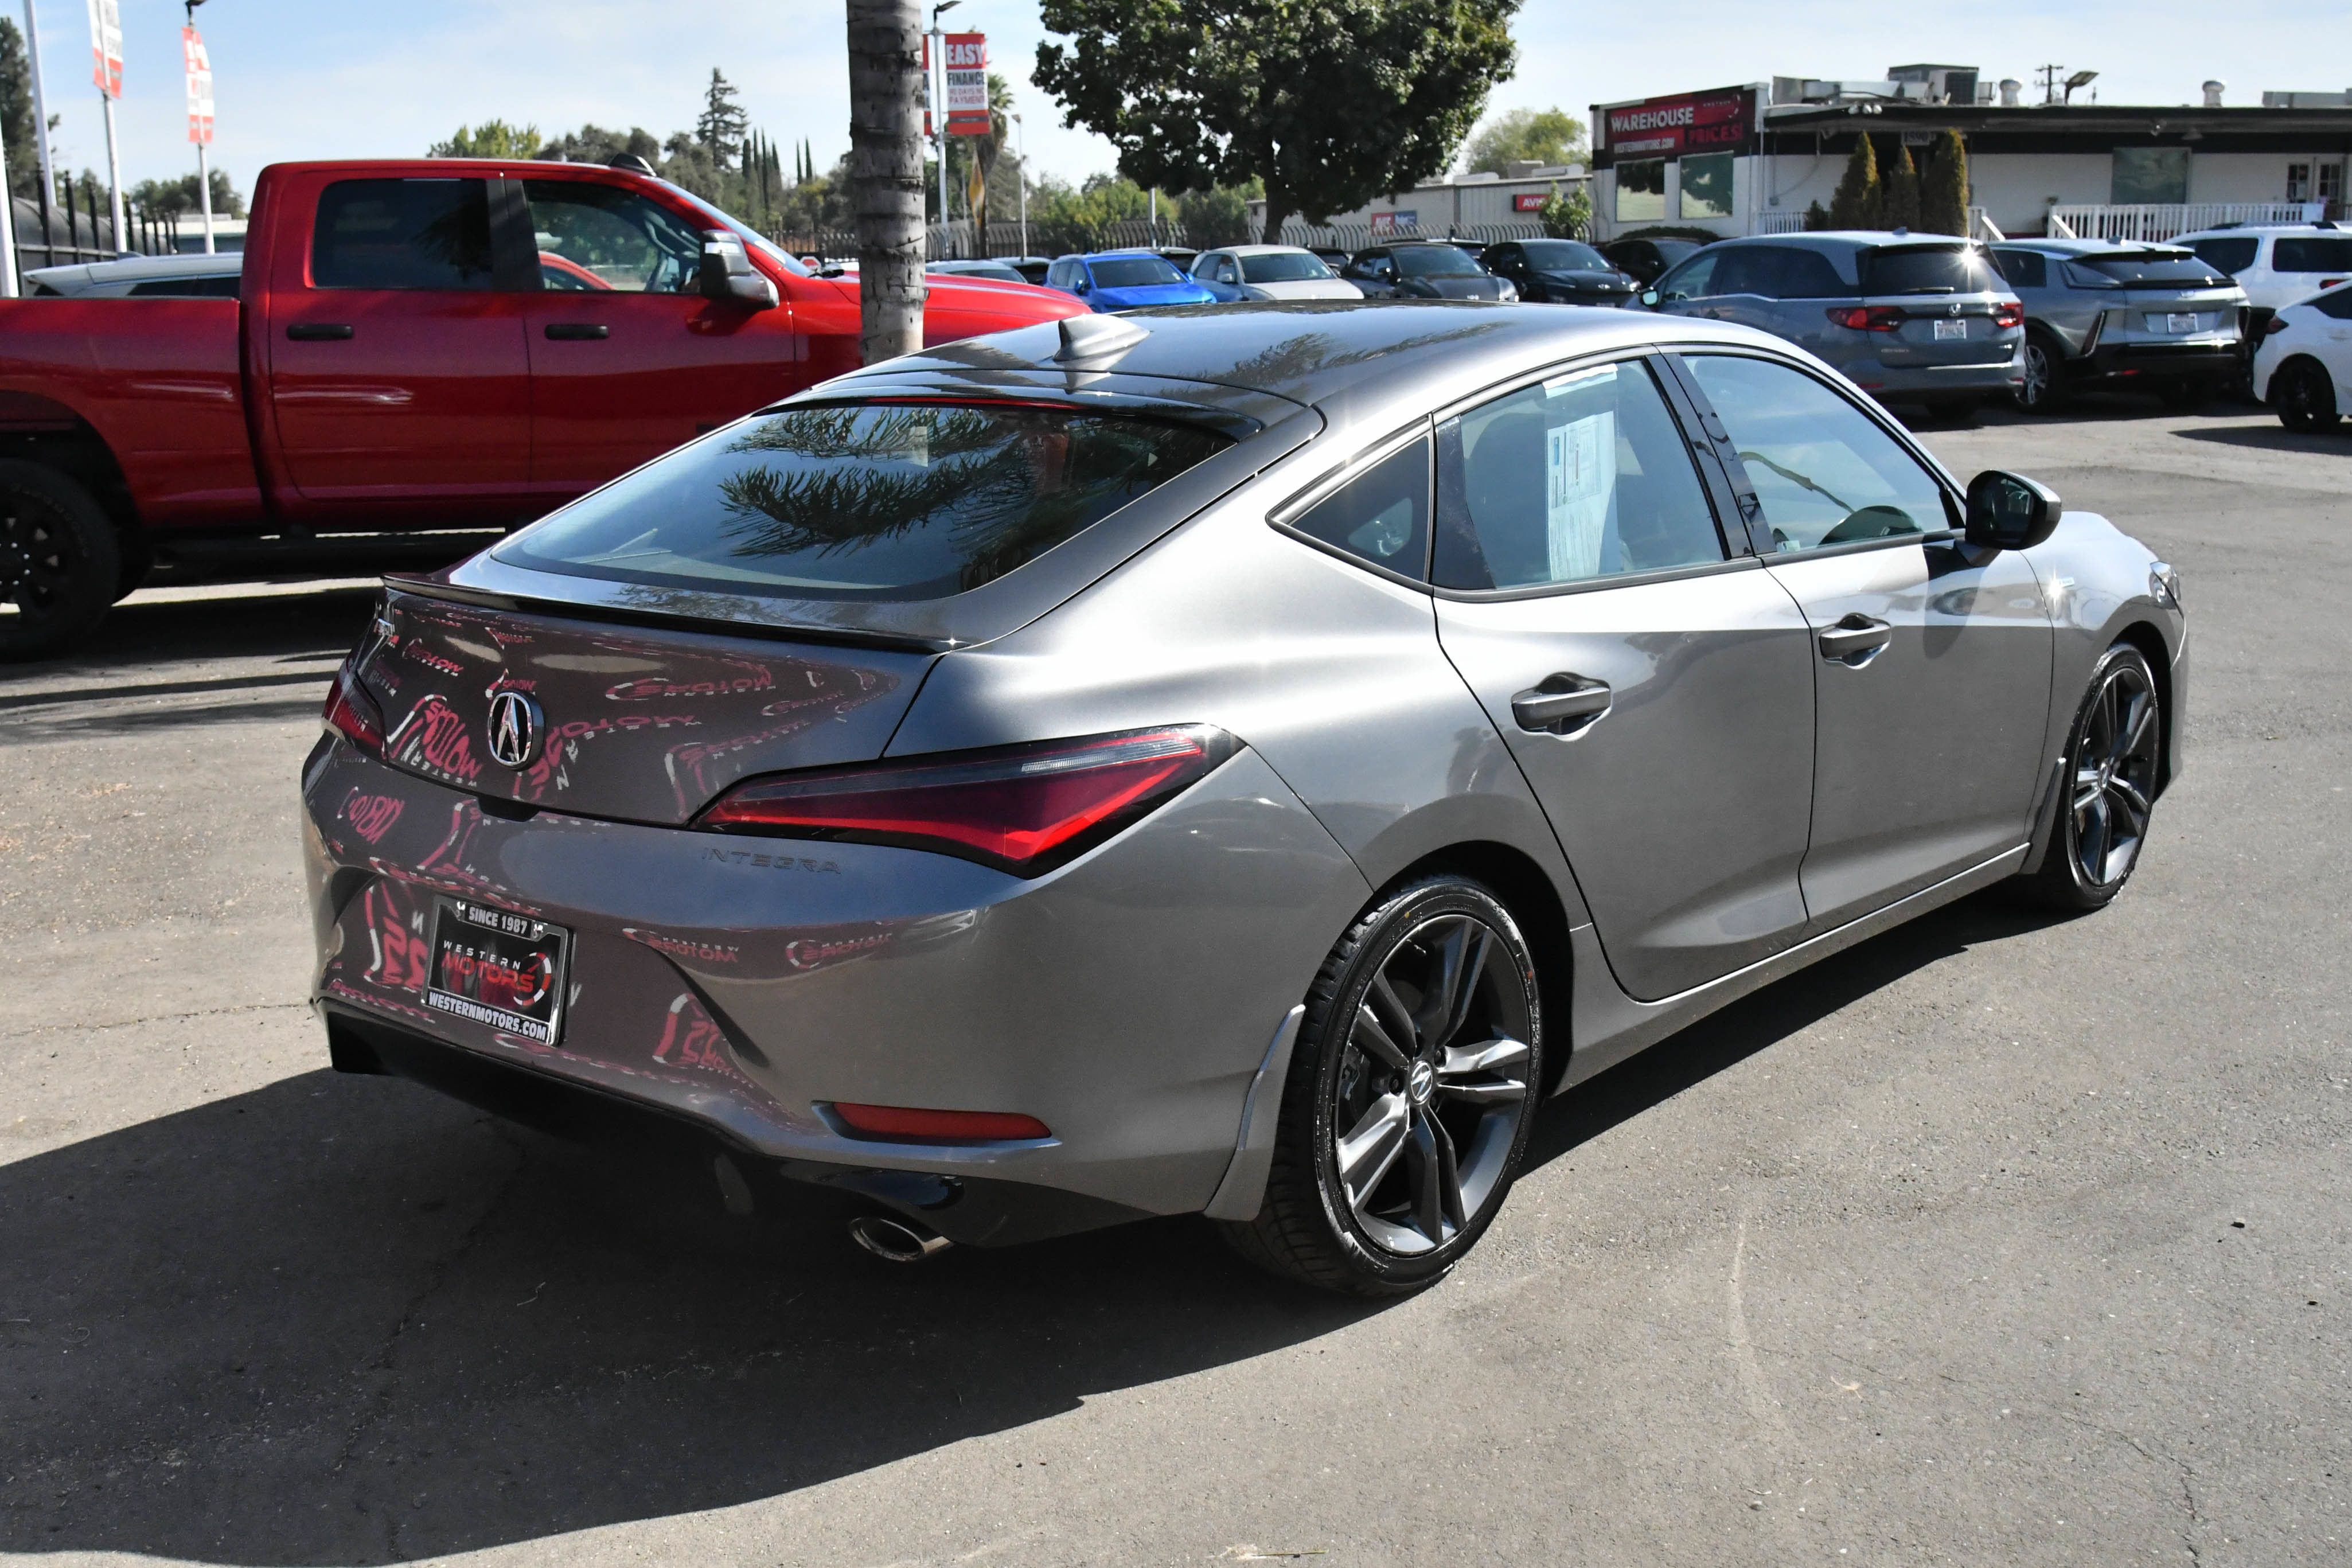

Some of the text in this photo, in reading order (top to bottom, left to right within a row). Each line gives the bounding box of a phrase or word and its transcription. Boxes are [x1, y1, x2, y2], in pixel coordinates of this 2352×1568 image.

[946, 44, 984, 65] EASY
[1611, 107, 1694, 132] WAREHOUSE
[702, 847, 841, 875] INTEGRA
[469, 906, 528, 934] SINCE 1987
[443, 940, 521, 970] WESTERN
[441, 951, 535, 993] MOTORS
[429, 992, 547, 1041] WESTERNMOTORS.COM
